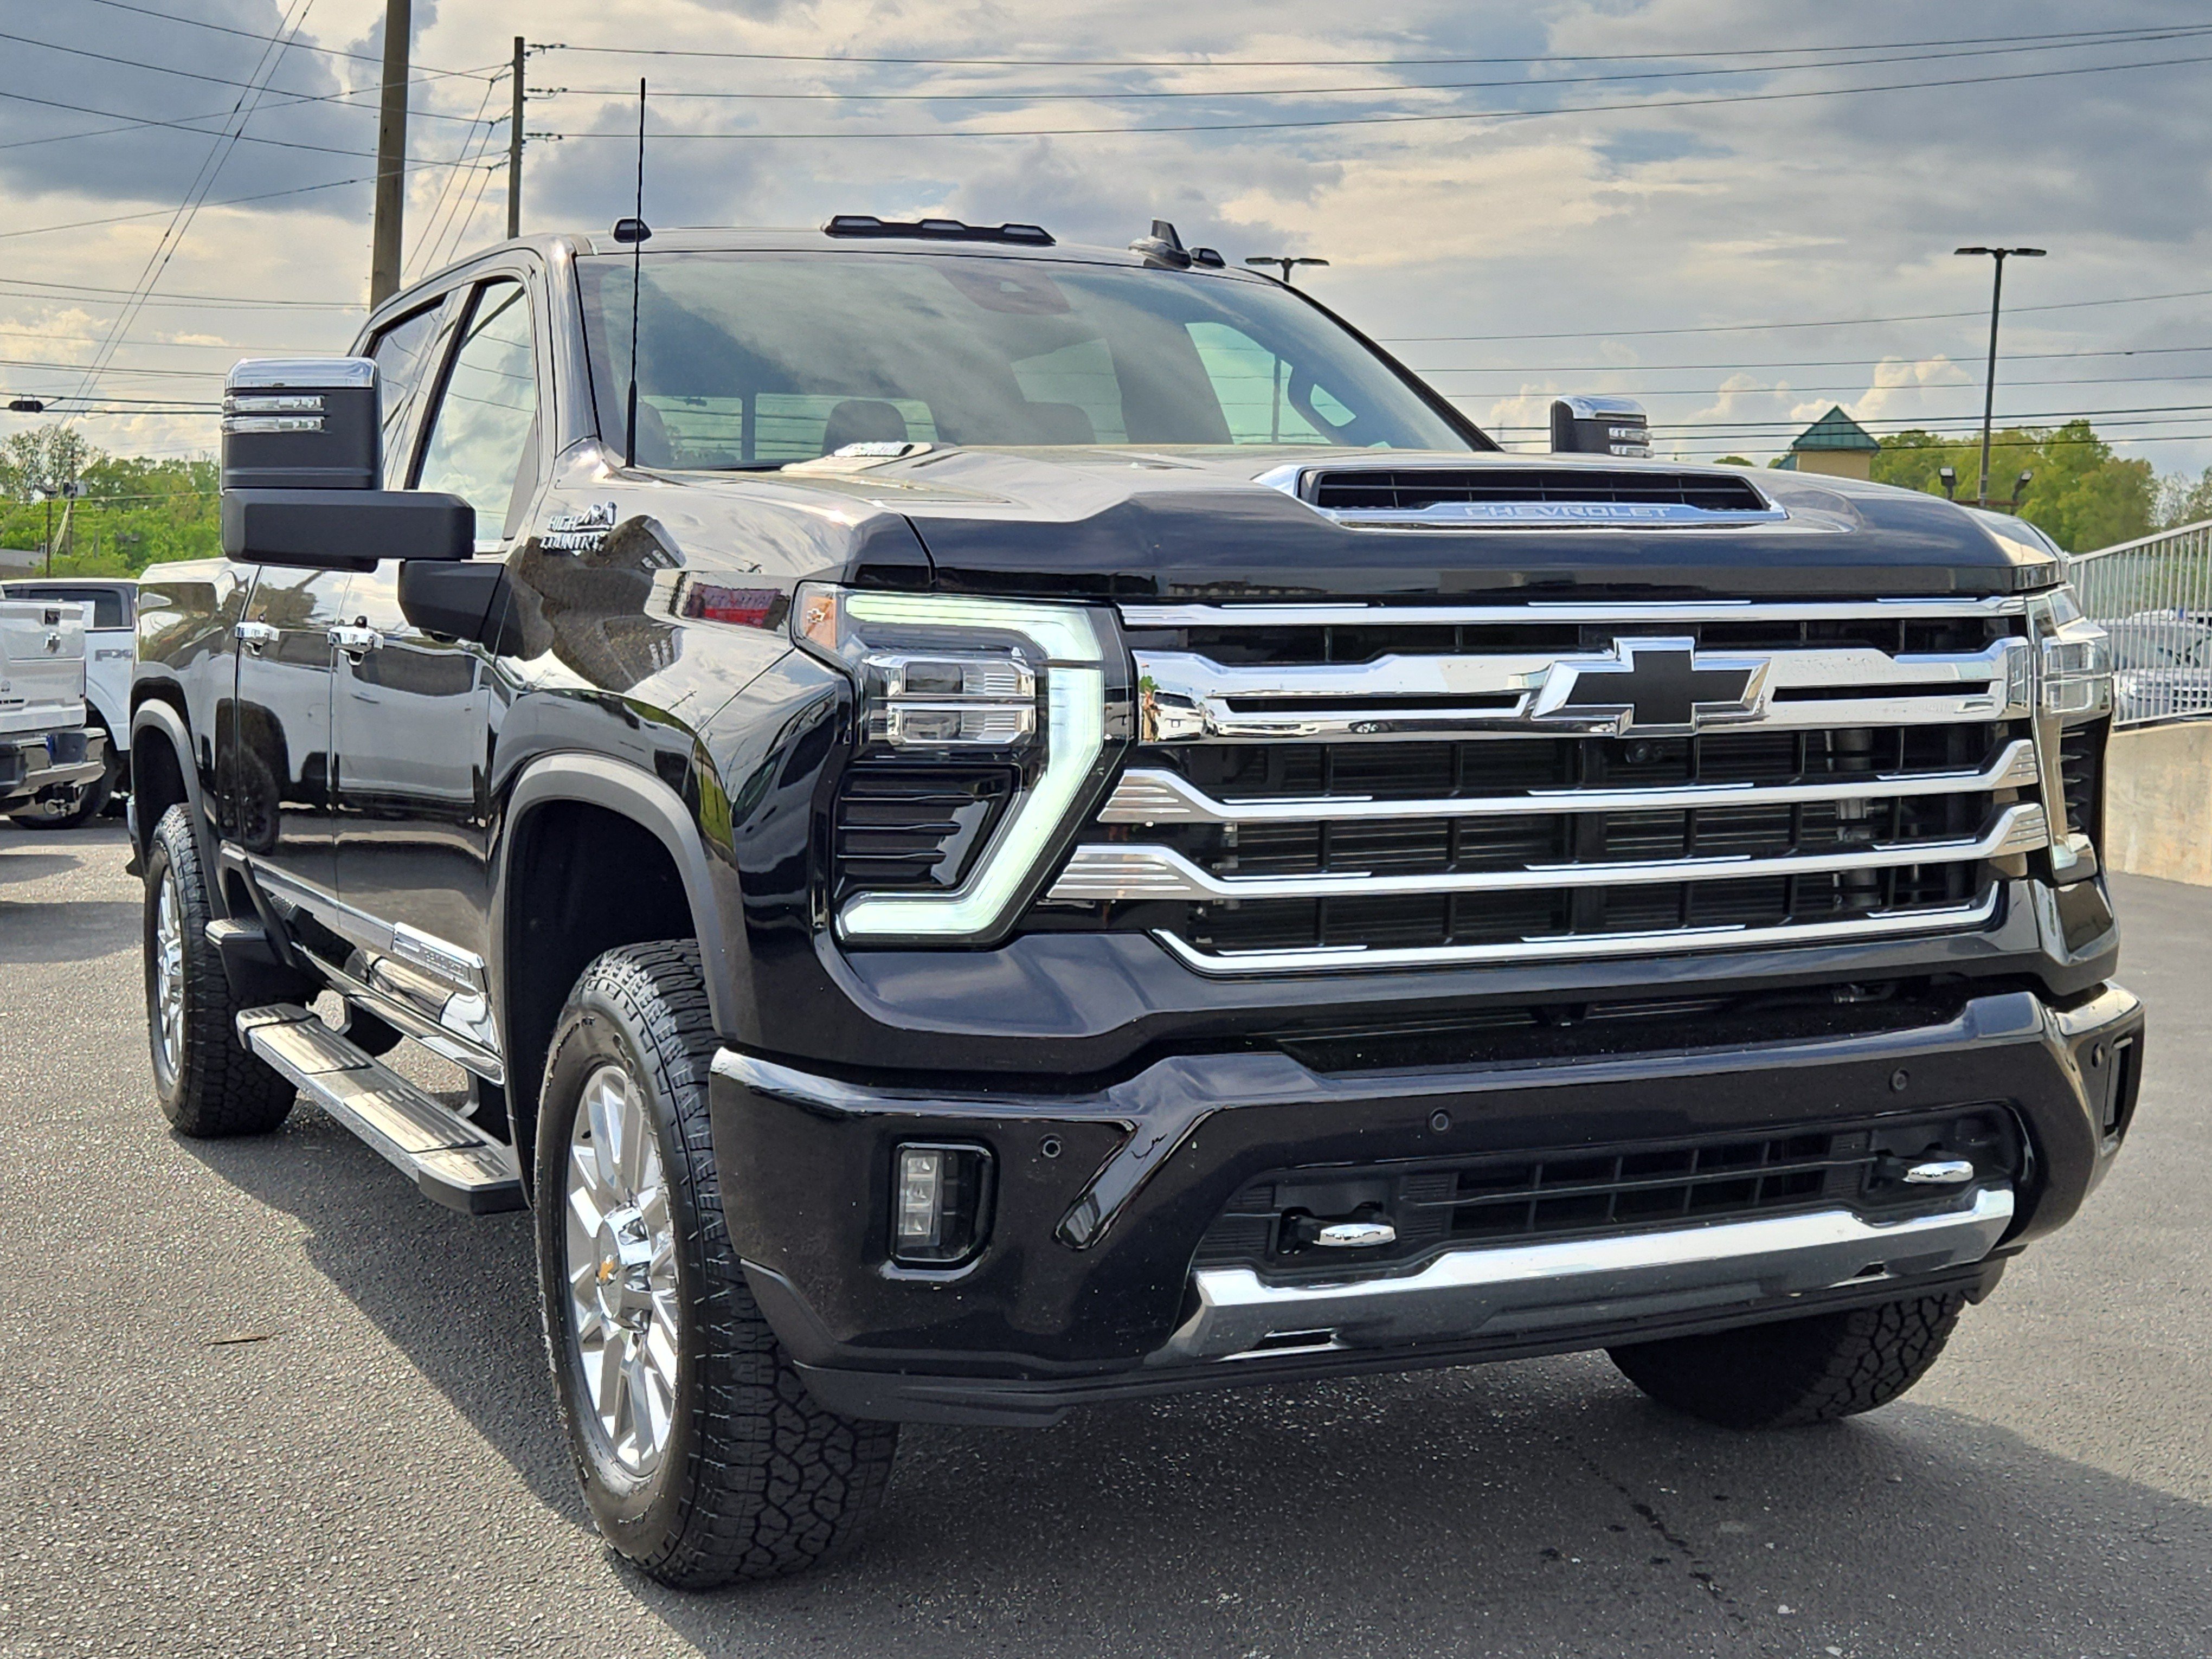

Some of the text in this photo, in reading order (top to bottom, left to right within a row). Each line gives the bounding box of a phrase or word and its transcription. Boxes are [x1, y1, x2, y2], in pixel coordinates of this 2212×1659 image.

[1464, 505, 1671, 518] CHEVROLET
[548, 515, 582, 532] HIGH
[539, 533, 607, 552] COUNTRY
